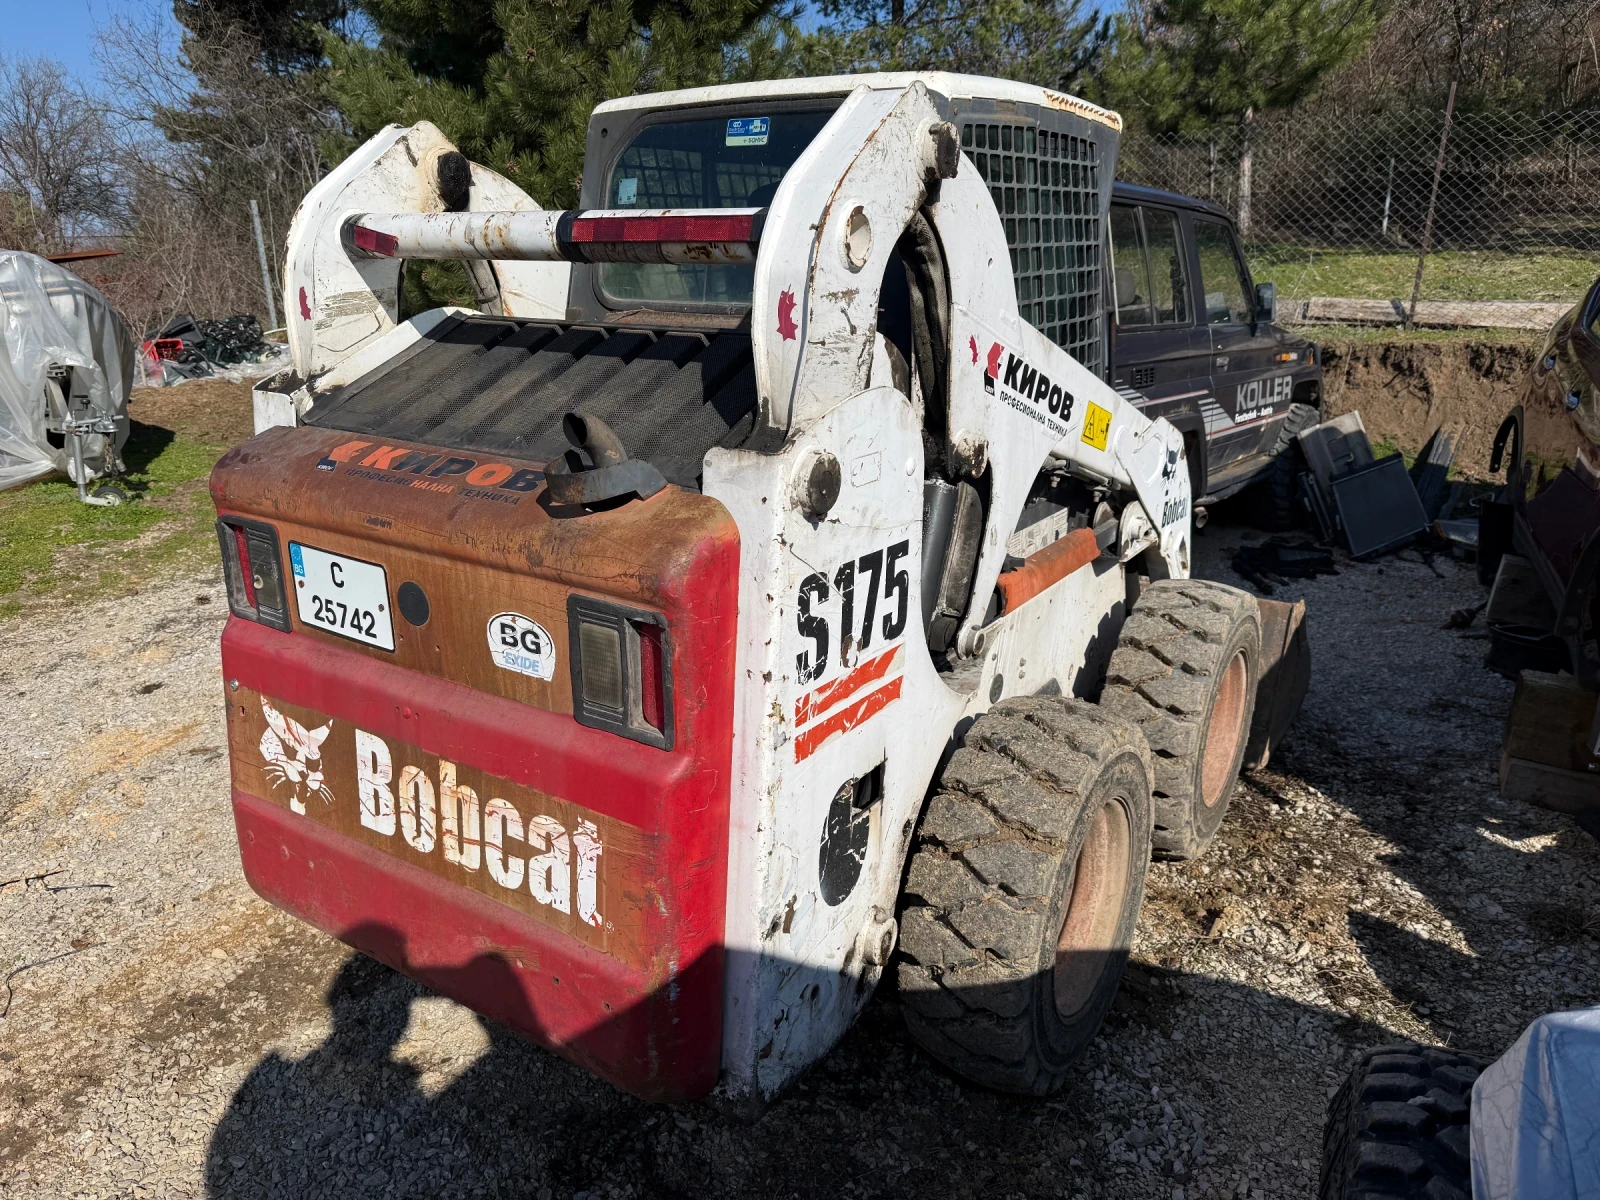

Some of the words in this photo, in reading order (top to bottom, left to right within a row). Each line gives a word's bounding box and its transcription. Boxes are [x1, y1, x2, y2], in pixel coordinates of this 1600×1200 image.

[1003, 353, 1075, 422] КИРОВ
[1236, 375, 1292, 412] KOLLER
[1000, 391, 1046, 425] ПРОФЕСИОНАЛНА
[1047, 418, 1068, 437] ТЕХНИКА
[344, 467, 455, 494] ПРОФЕСИОНАЛНА
[458, 487, 520, 506] ТЕХНИКА
[358, 445, 548, 492] КИРОВ
[294, 563, 303, 574] BG
[330, 561, 345, 588] C
[312, 595, 377, 639] 25742
[796, 539, 910, 686] S175
[500, 622, 541, 654] BG
[503, 652, 539, 672] EXIDE
[355, 728, 603, 928] Bobcat
